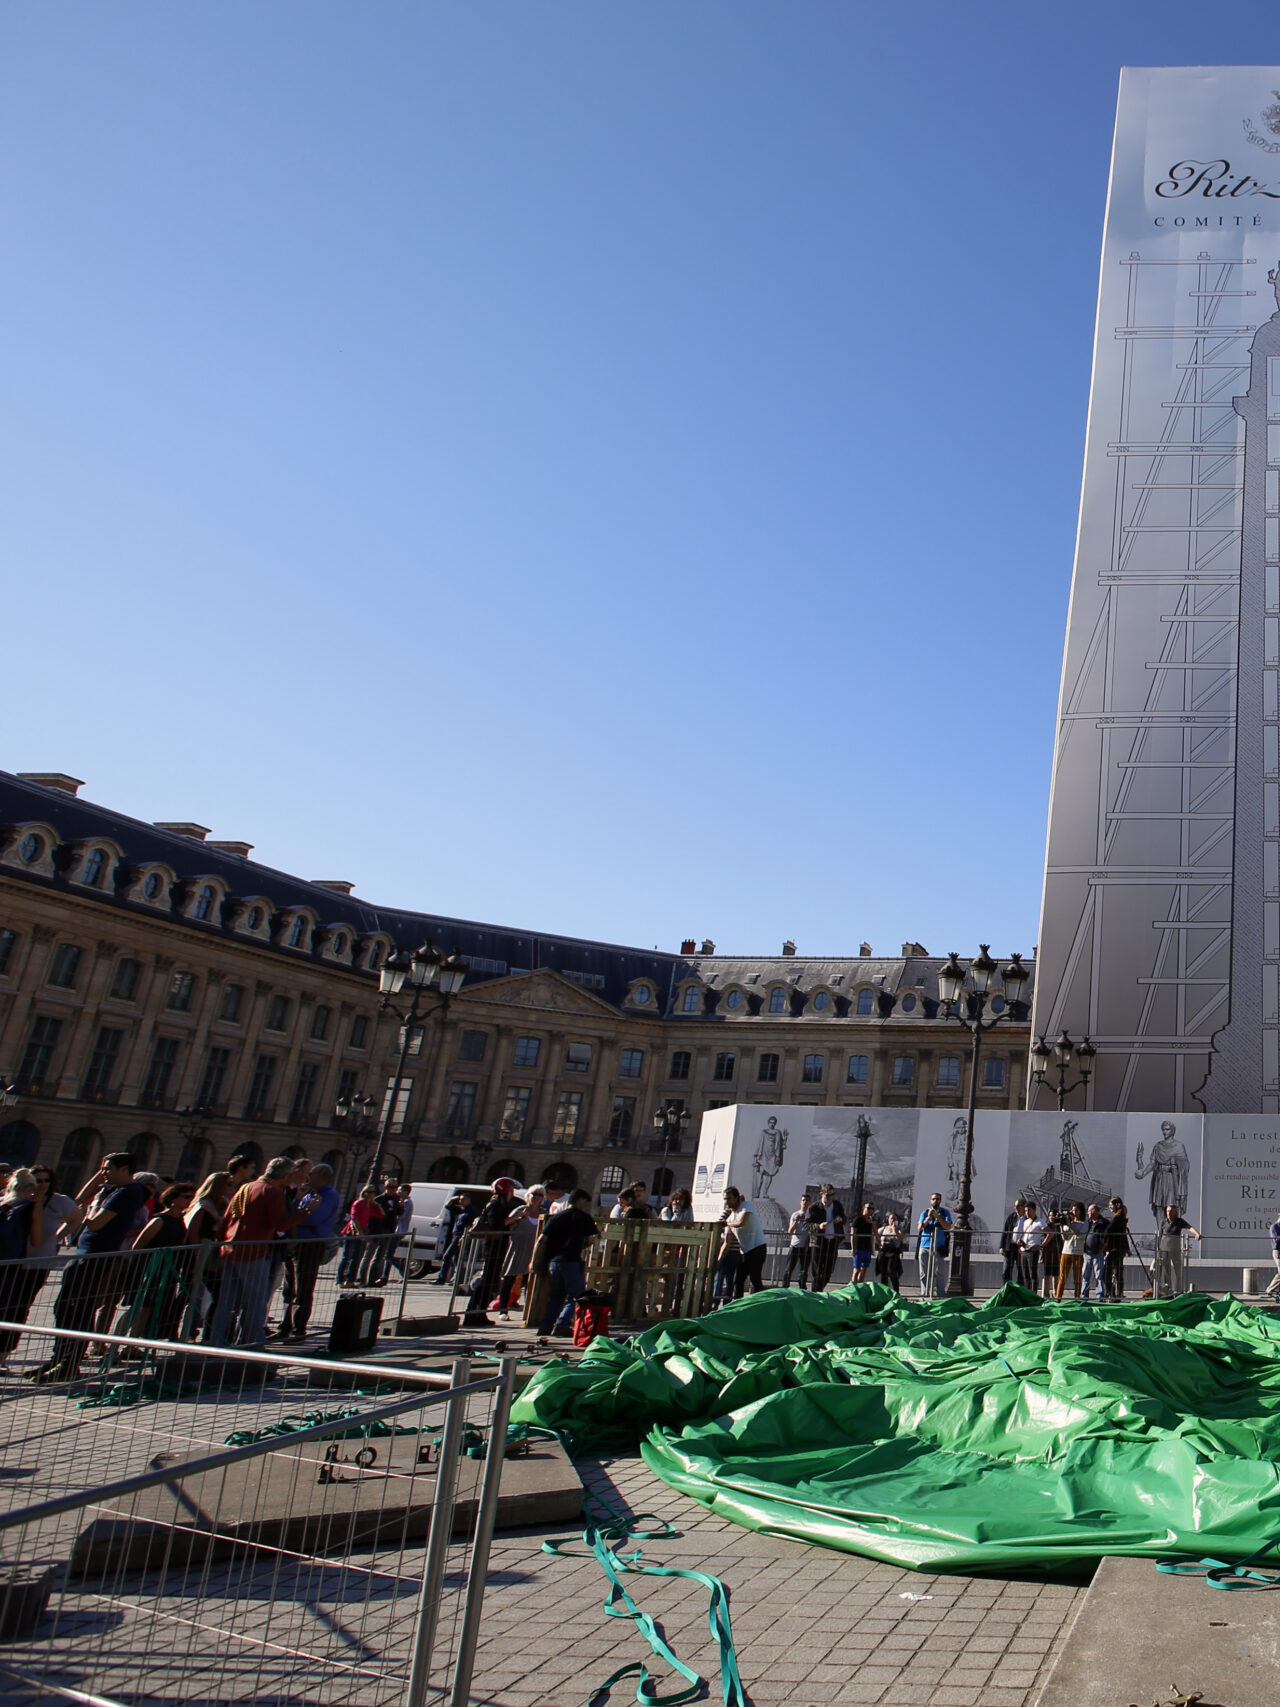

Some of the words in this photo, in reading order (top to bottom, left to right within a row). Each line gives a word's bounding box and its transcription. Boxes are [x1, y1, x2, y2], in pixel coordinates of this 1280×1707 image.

[1154, 213, 1262, 227] COMITÉ
[1231, 1130, 1246, 1140] La
[1269, 1145, 1280, 1153] de
[1225, 1157, 1277, 1169] Colonne
[1241, 1185, 1276, 1200] Ritz
[1216, 1216, 1271, 1230] Comité
